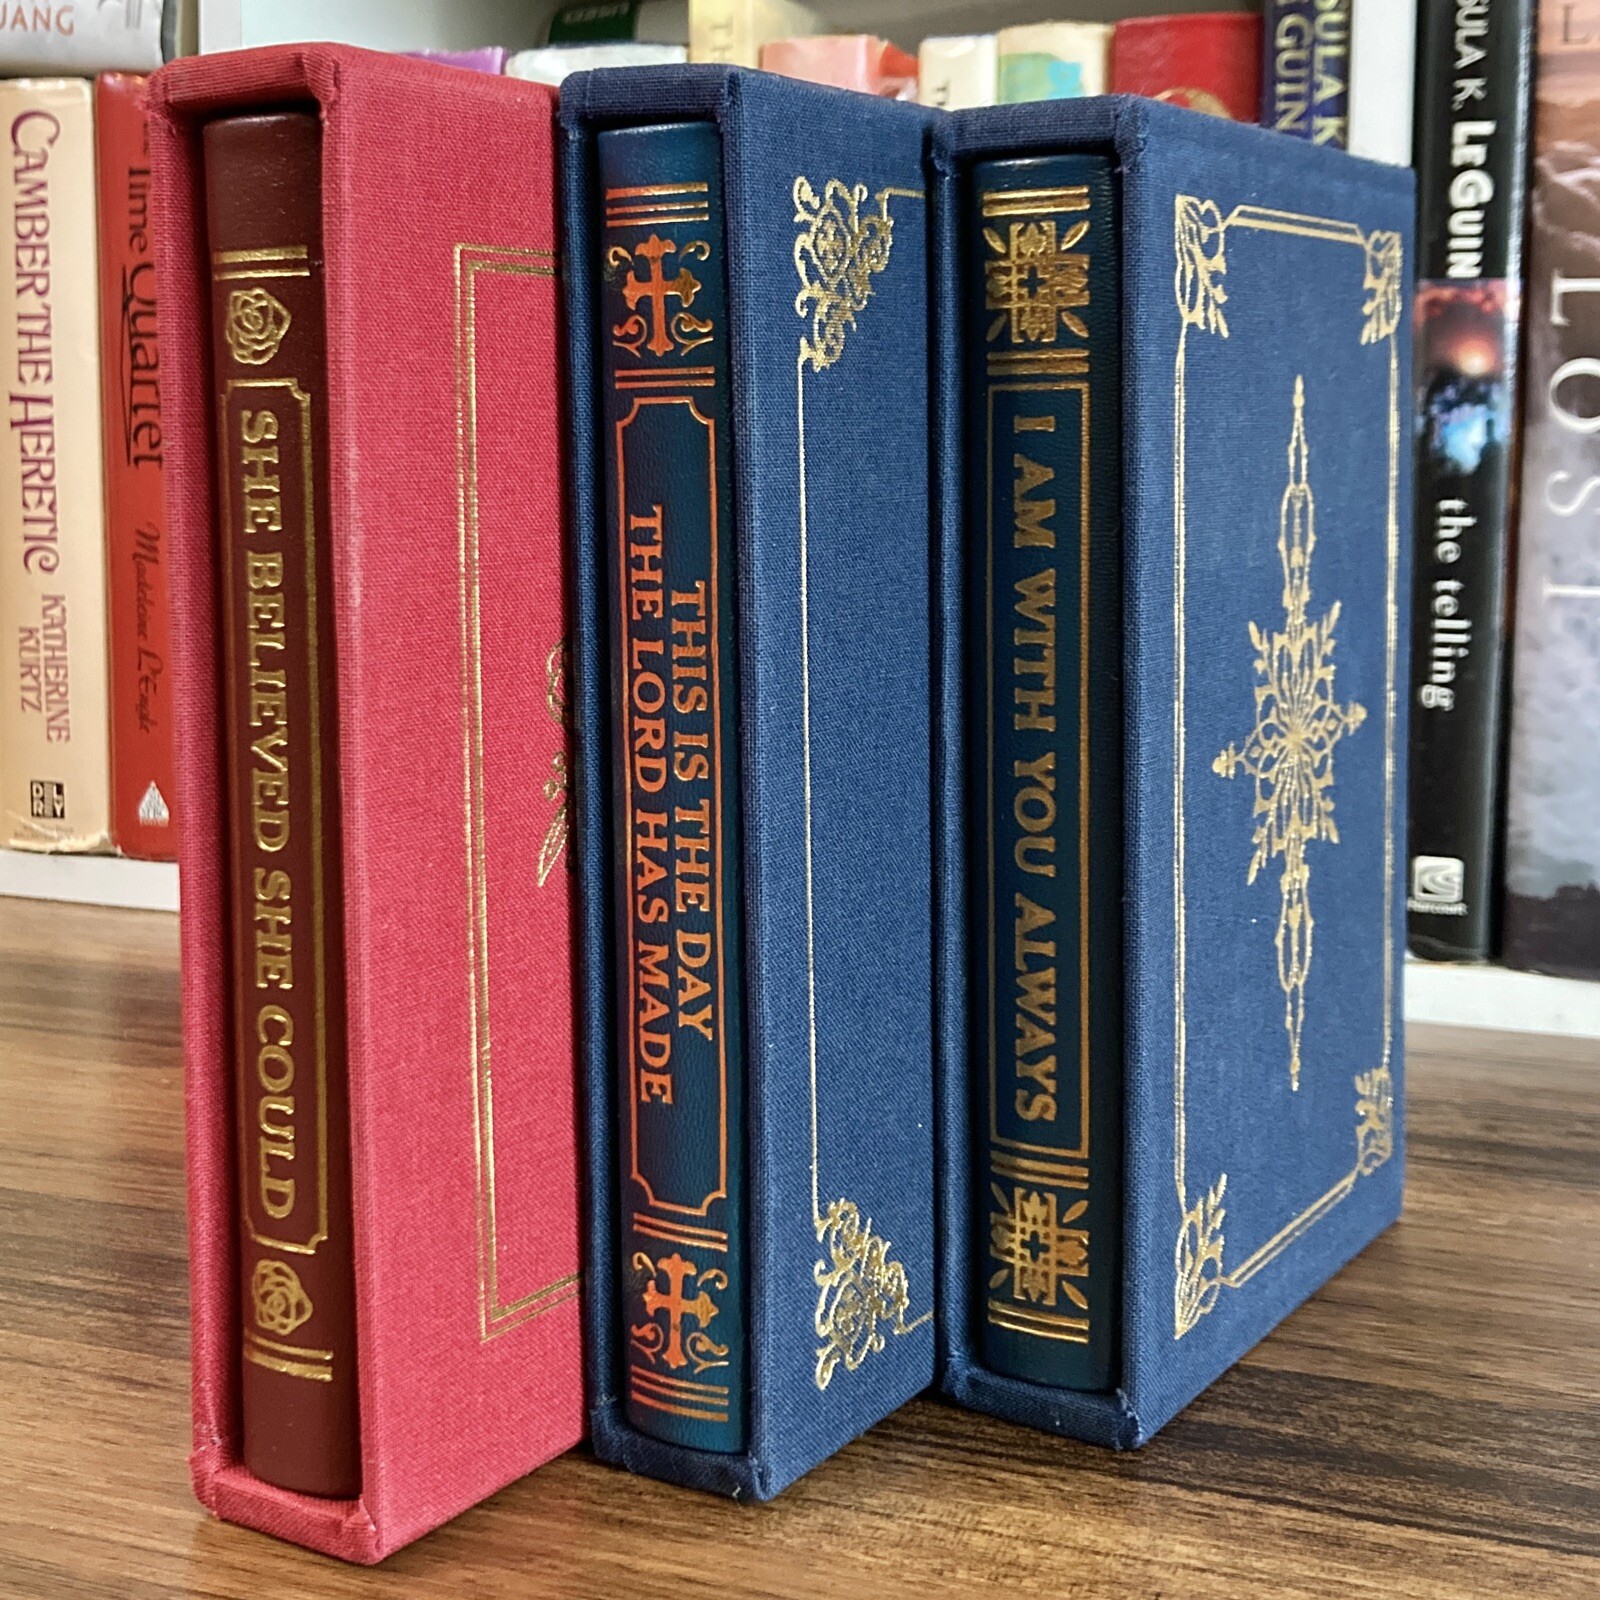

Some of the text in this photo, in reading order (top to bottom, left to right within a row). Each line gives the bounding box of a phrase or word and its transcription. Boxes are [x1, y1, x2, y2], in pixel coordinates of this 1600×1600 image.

[1275, 13, 1314, 131] GUIN
[9, 111, 61, 575] CAMBER THE HERETIC
[19, 626, 43, 714] KURTZ
[42, 593, 71, 744] KATHERINE
[1420, 498, 1478, 712] the telling
[33, 782, 64, 799] DL
[33, 799, 64, 817] RY
[240, 409, 296, 1220] SHE BELIEVED SHE COULD
[630, 504, 674, 1105] THE LORD HAS MADE
[671, 579, 714, 1041] THIS IS THE DAY
[1013, 415, 1058, 1122] I AM WITH YOU ALWAYS
